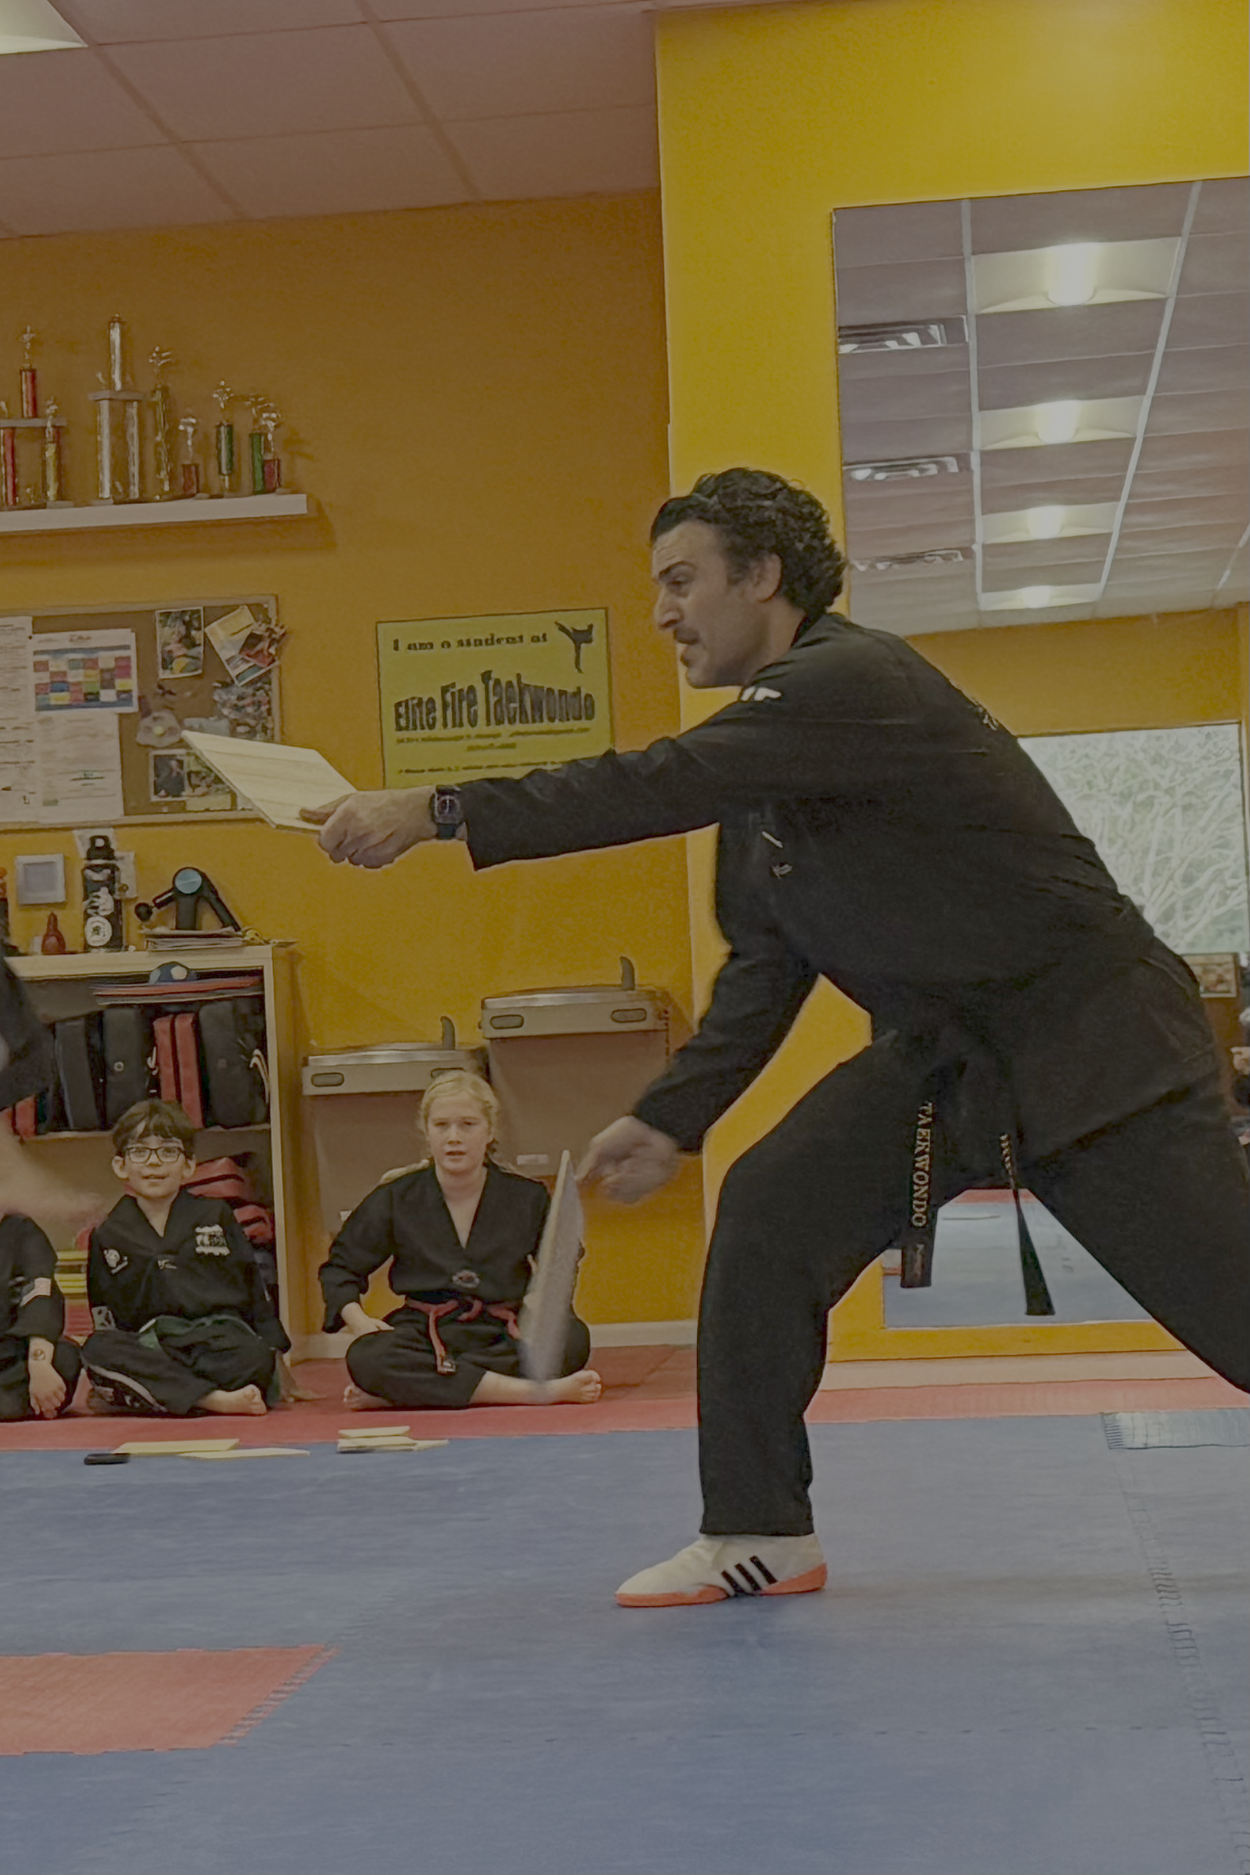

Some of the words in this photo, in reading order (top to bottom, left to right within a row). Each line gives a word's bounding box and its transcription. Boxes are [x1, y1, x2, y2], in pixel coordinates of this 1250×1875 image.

[393, 638, 400, 651] I
[407, 639, 434, 651] am
[441, 640, 452, 650] a
[457, 633, 524, 648] student
[530, 632, 548, 643] at
[394, 697, 437, 732] Elite
[441, 682, 478, 730] Fire
[481, 669, 596, 726] Taekwondo
[911, 1101, 933, 1227] TAEKWONDO
